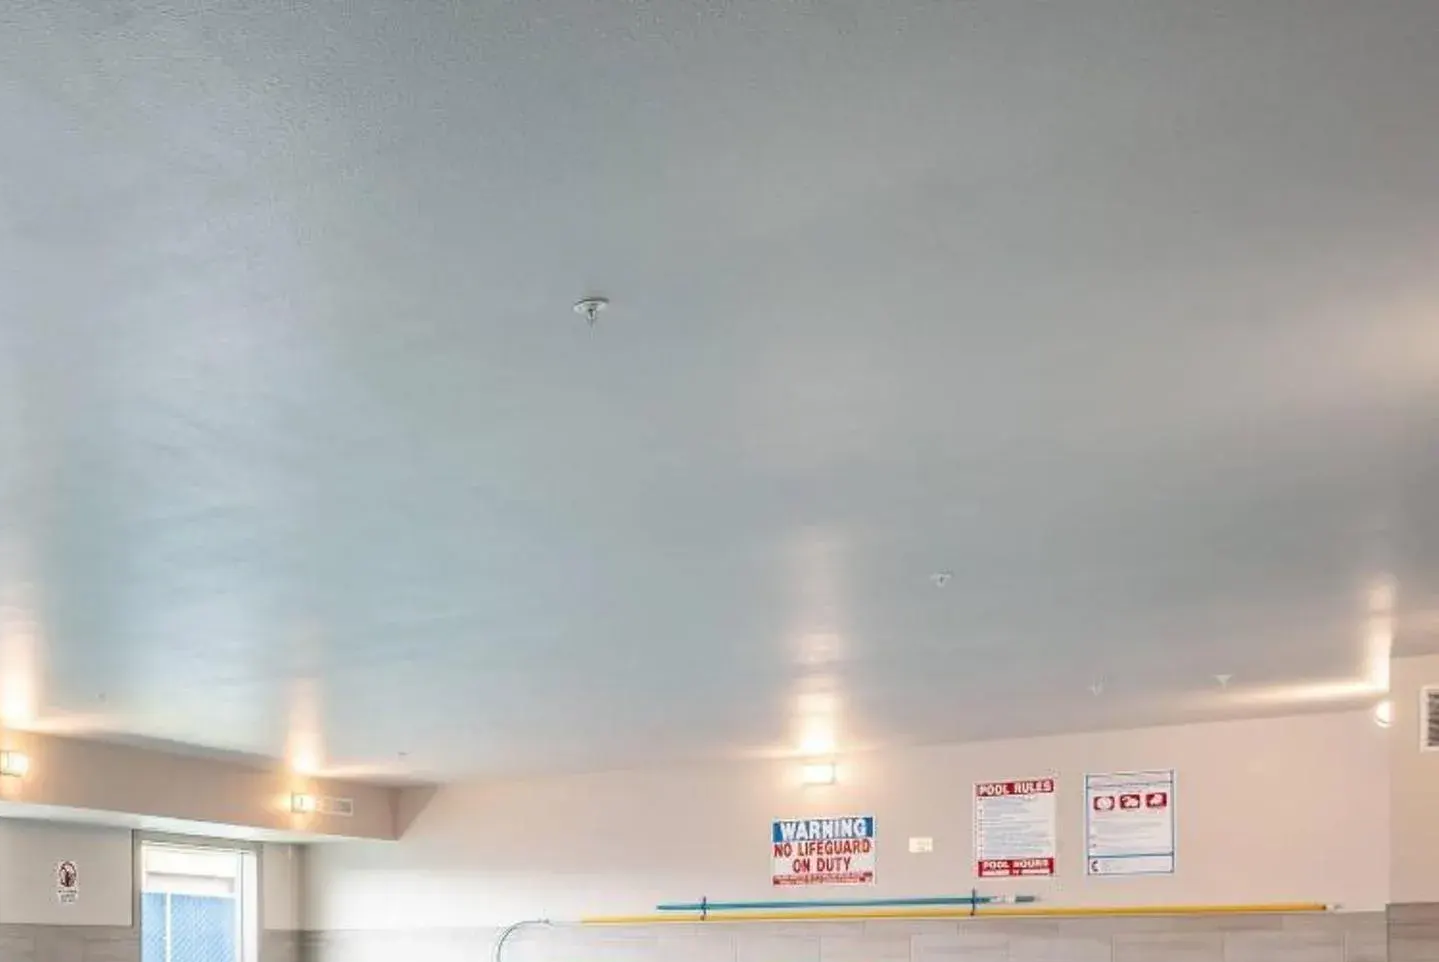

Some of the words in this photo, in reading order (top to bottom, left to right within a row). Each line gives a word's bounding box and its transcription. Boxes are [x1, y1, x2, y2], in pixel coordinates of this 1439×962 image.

[980, 782, 1008, 796] POOL
[781, 818, 867, 841] WARNING
[773, 842, 792, 857] NO
[797, 839, 871, 857] LIFEGUARD
[792, 859, 810, 873] ON
[816, 857, 852, 872] DUTY
